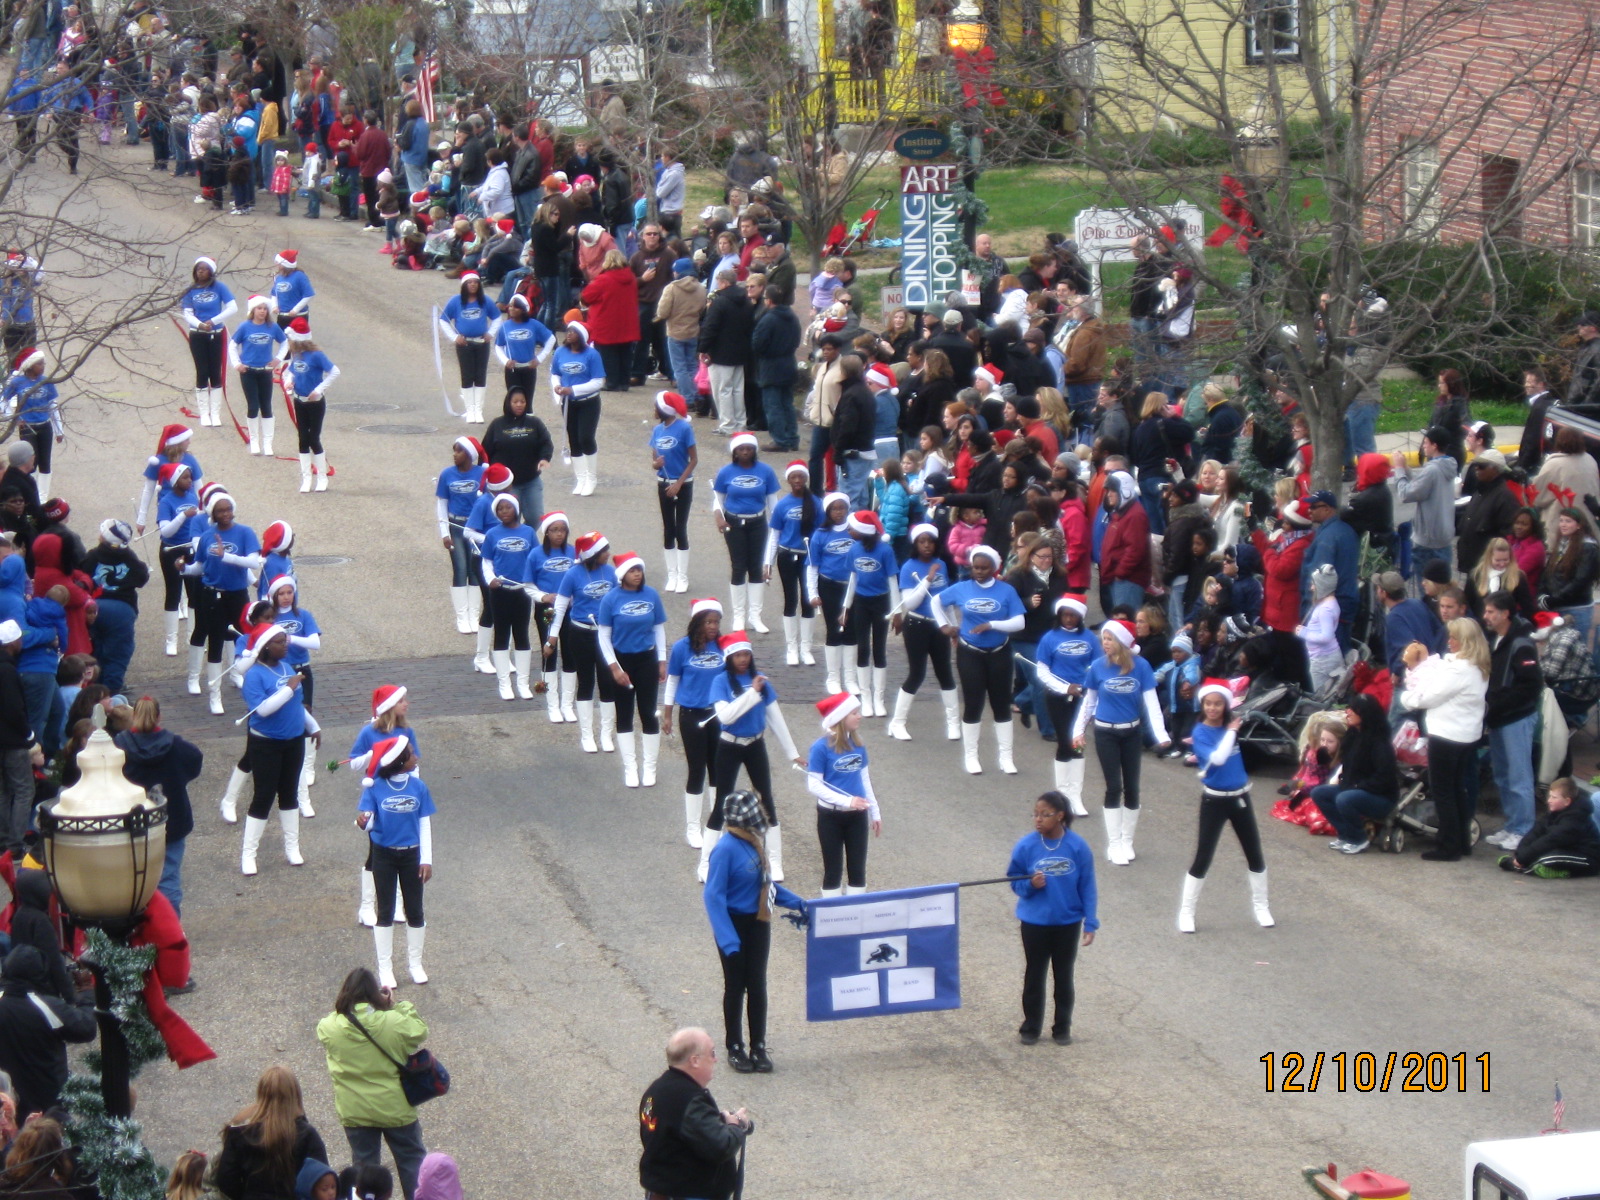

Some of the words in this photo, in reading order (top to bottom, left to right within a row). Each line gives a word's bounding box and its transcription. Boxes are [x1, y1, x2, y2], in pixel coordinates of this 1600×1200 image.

[902, 137, 942, 147] Institute
[902, 165, 957, 193] ART
[1081, 226, 1111, 240] Olde
[903, 194, 928, 306] DINING
[931, 193, 957, 303] HOPPING
[887, 293, 903, 304] NO
